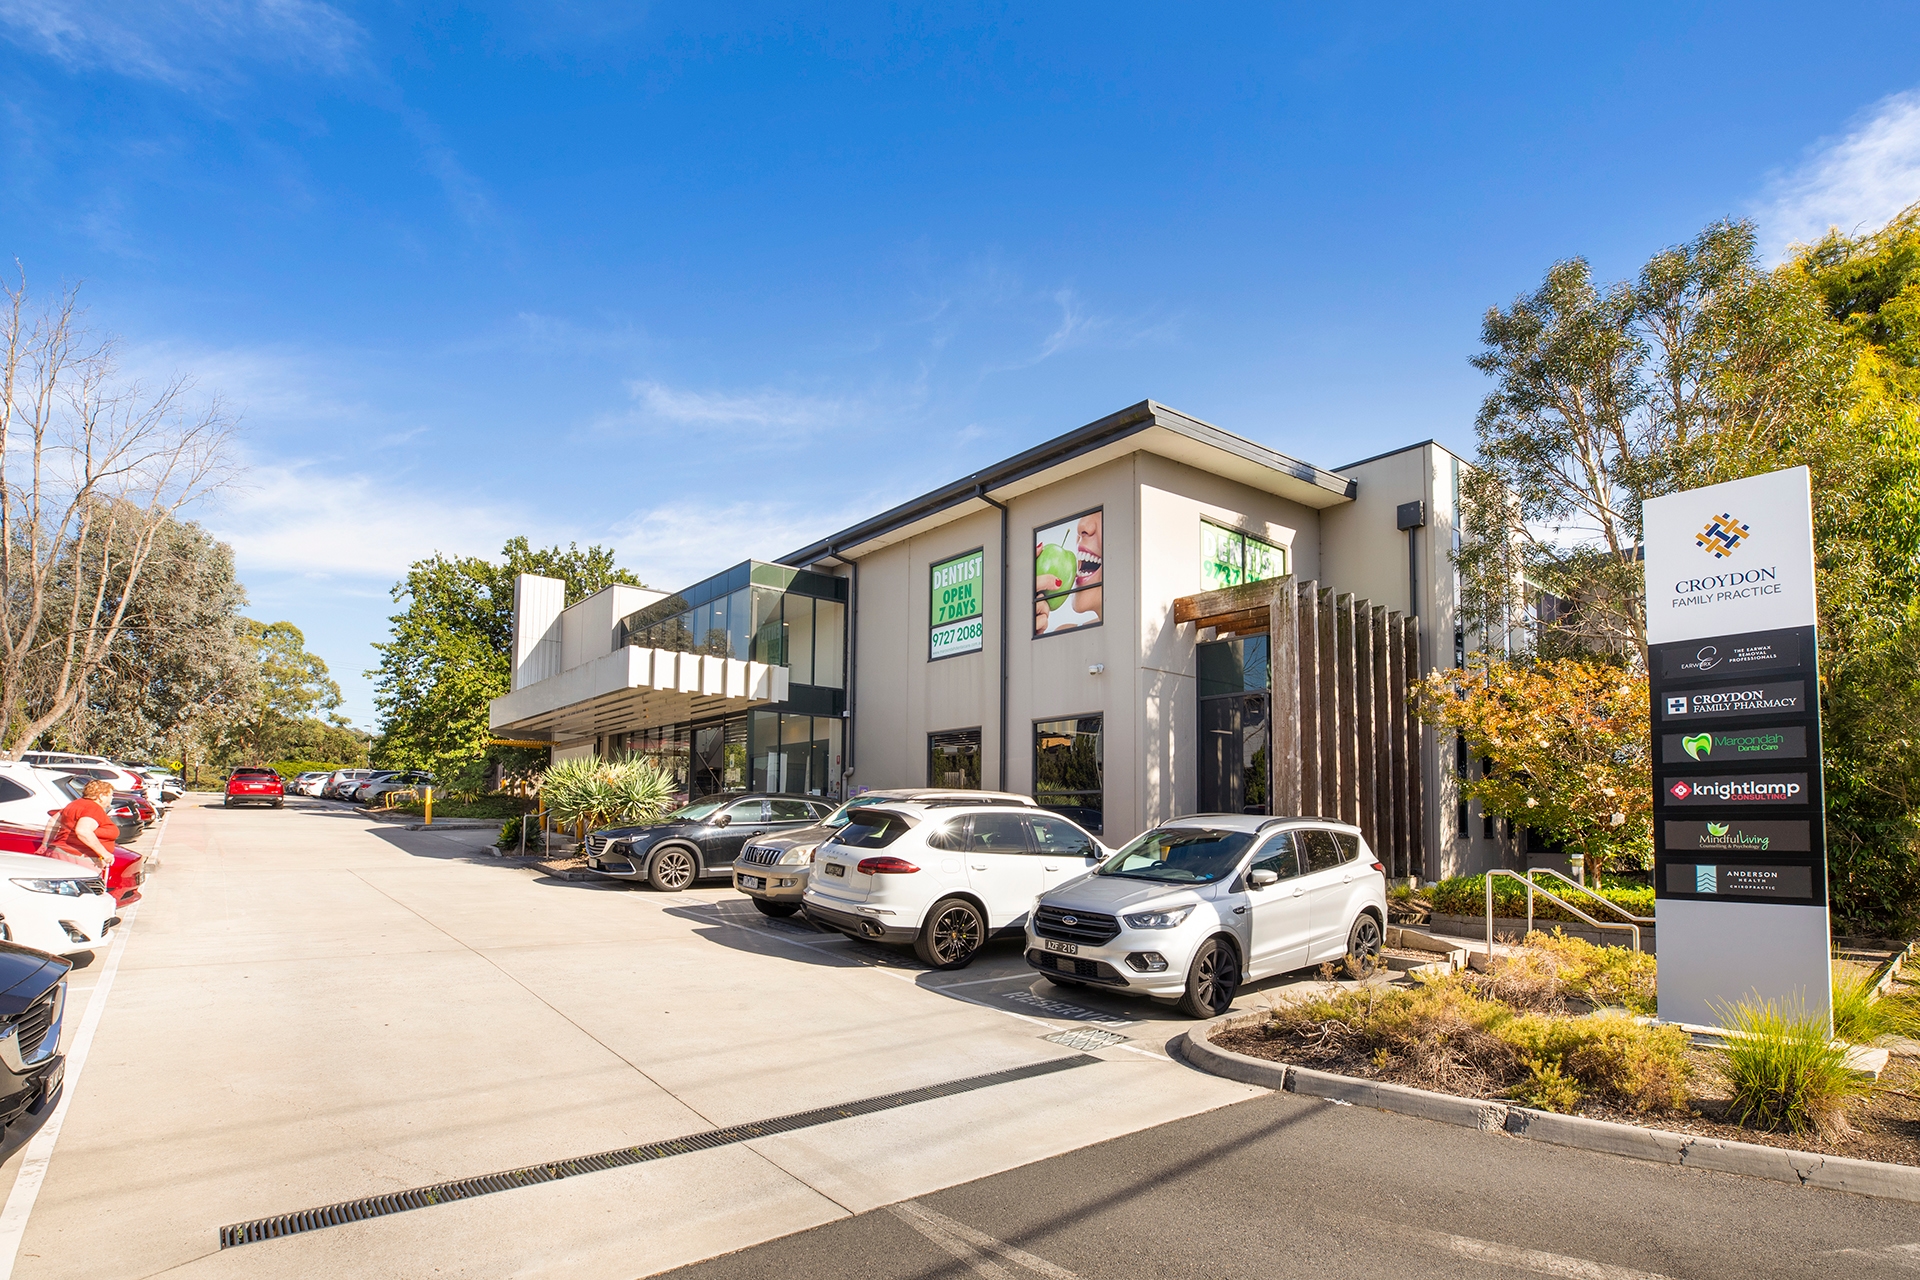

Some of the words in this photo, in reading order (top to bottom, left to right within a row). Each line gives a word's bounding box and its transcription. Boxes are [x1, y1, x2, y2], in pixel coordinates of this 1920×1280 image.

[934, 557, 982, 590] DENTIST
[1675, 566, 1777, 594] CROYDON
[942, 583, 972, 605] OPEN
[1672, 593, 1714, 608] FAMILY
[1717, 583, 1782, 602] PRACTICE
[939, 606, 946, 622] 7
[948, 598, 976, 620] DAYS
[933, 629, 955, 647] 9727
[957, 622, 983, 641] 2088
[1728, 654, 1778, 663] PROFESSIONALS
[1693, 690, 1764, 705] CROYDON
[1693, 703, 1732, 713] FAMILY
[1733, 697, 1797, 711] PHARMACY
[1715, 734, 1784, 747] Maroondah
[1693, 781, 1800, 800] knightlamp
